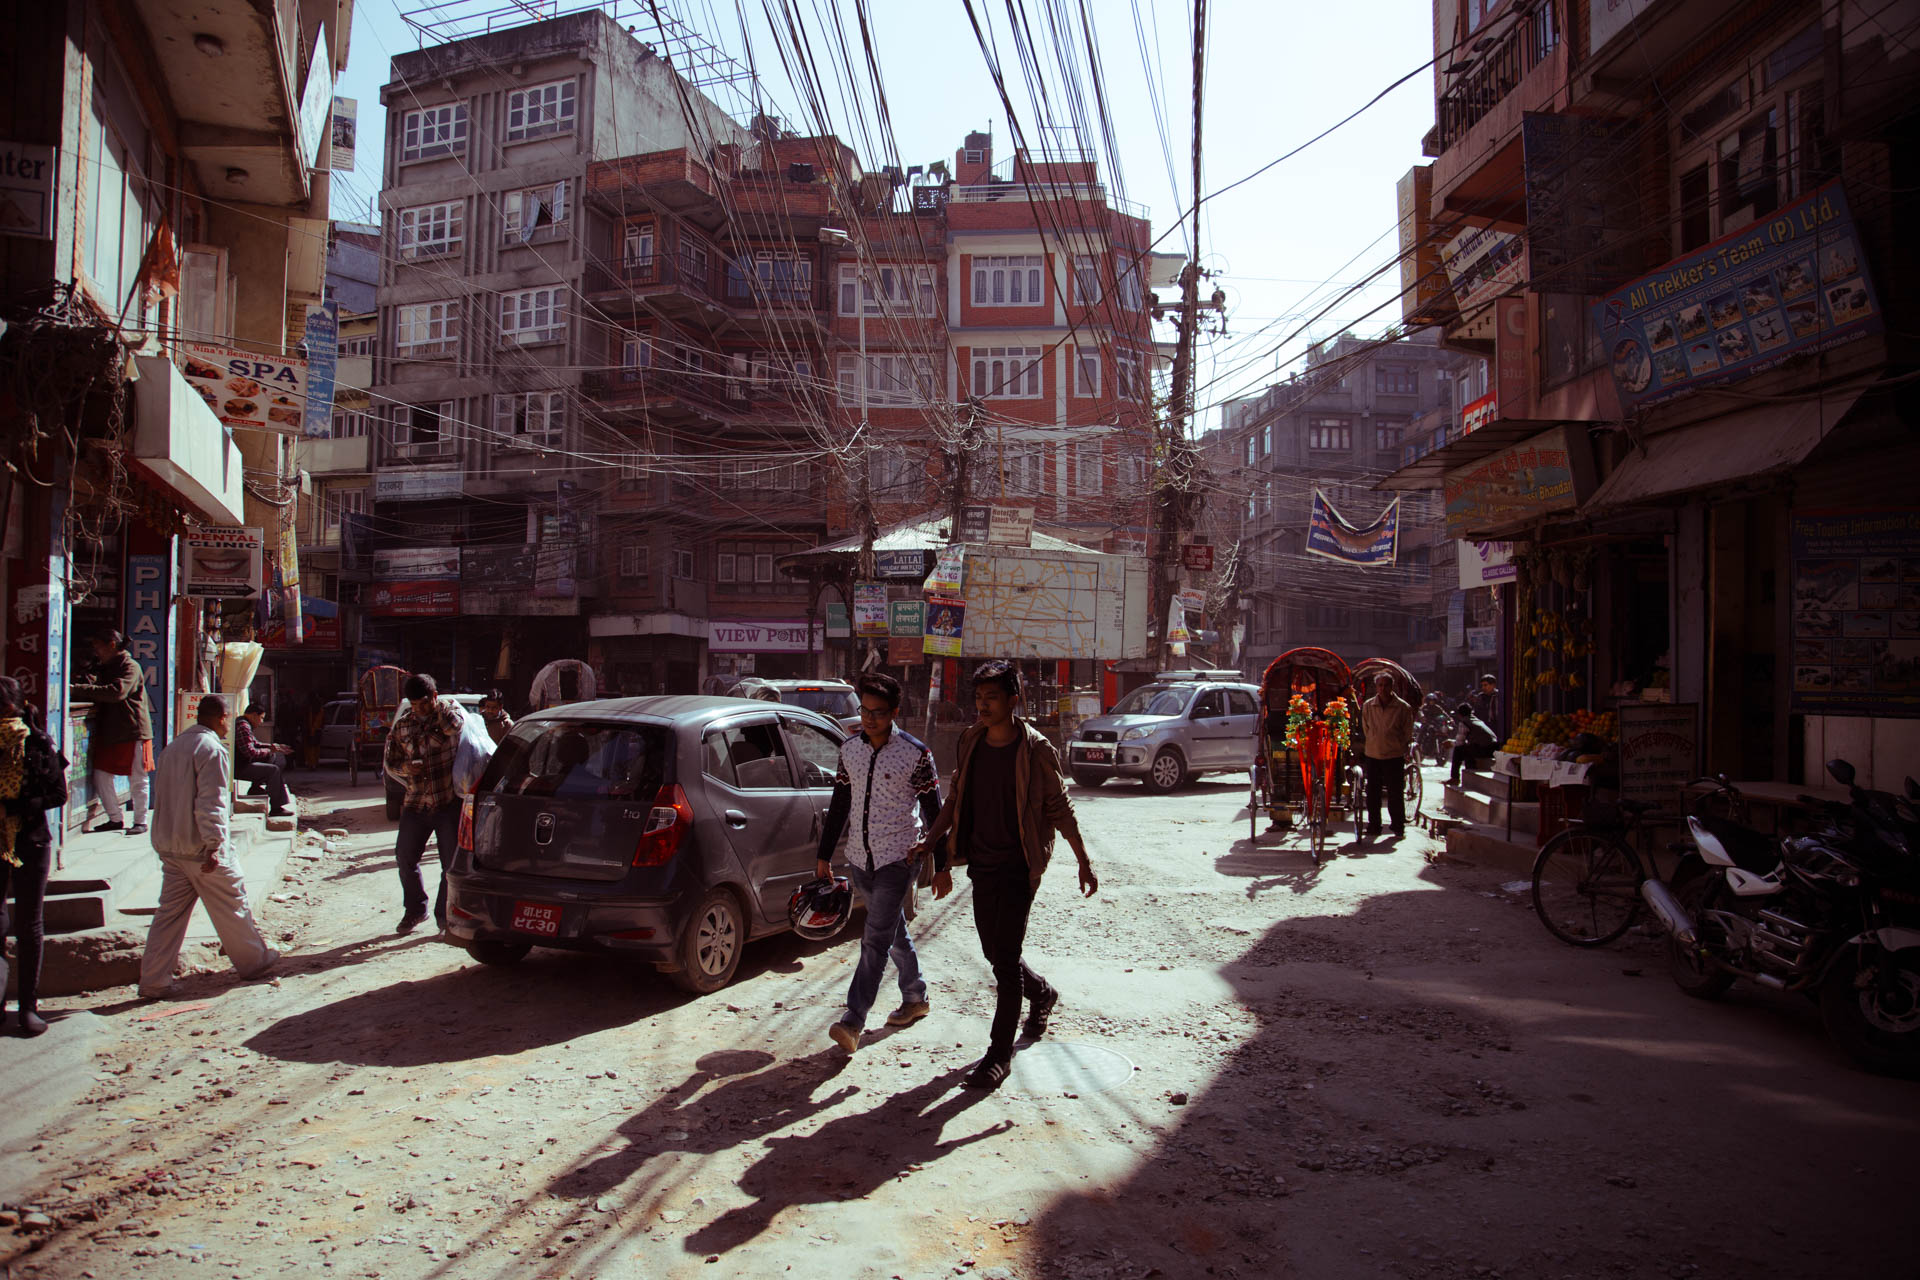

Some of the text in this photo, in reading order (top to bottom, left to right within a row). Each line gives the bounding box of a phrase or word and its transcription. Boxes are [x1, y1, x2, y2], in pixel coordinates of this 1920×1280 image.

[0, 151, 45, 180] ter
[1629, 195, 1840, 310] All Trekker's Team (P) Ltd.
[193, 344, 224, 356] Nina's
[226, 349, 259, 362] Beauty
[263, 354, 298, 367] Parlour
[228, 359, 299, 384] SPA
[1539, 479, 1573, 500] Bhandar
[1815, 519, 1849, 537] Tourist
[1851, 513, 1906, 536] Information
[189, 533, 258, 542] DENTAL
[189, 540, 259, 549] CLINIC
[714, 628, 818, 643] VIEW POINT
